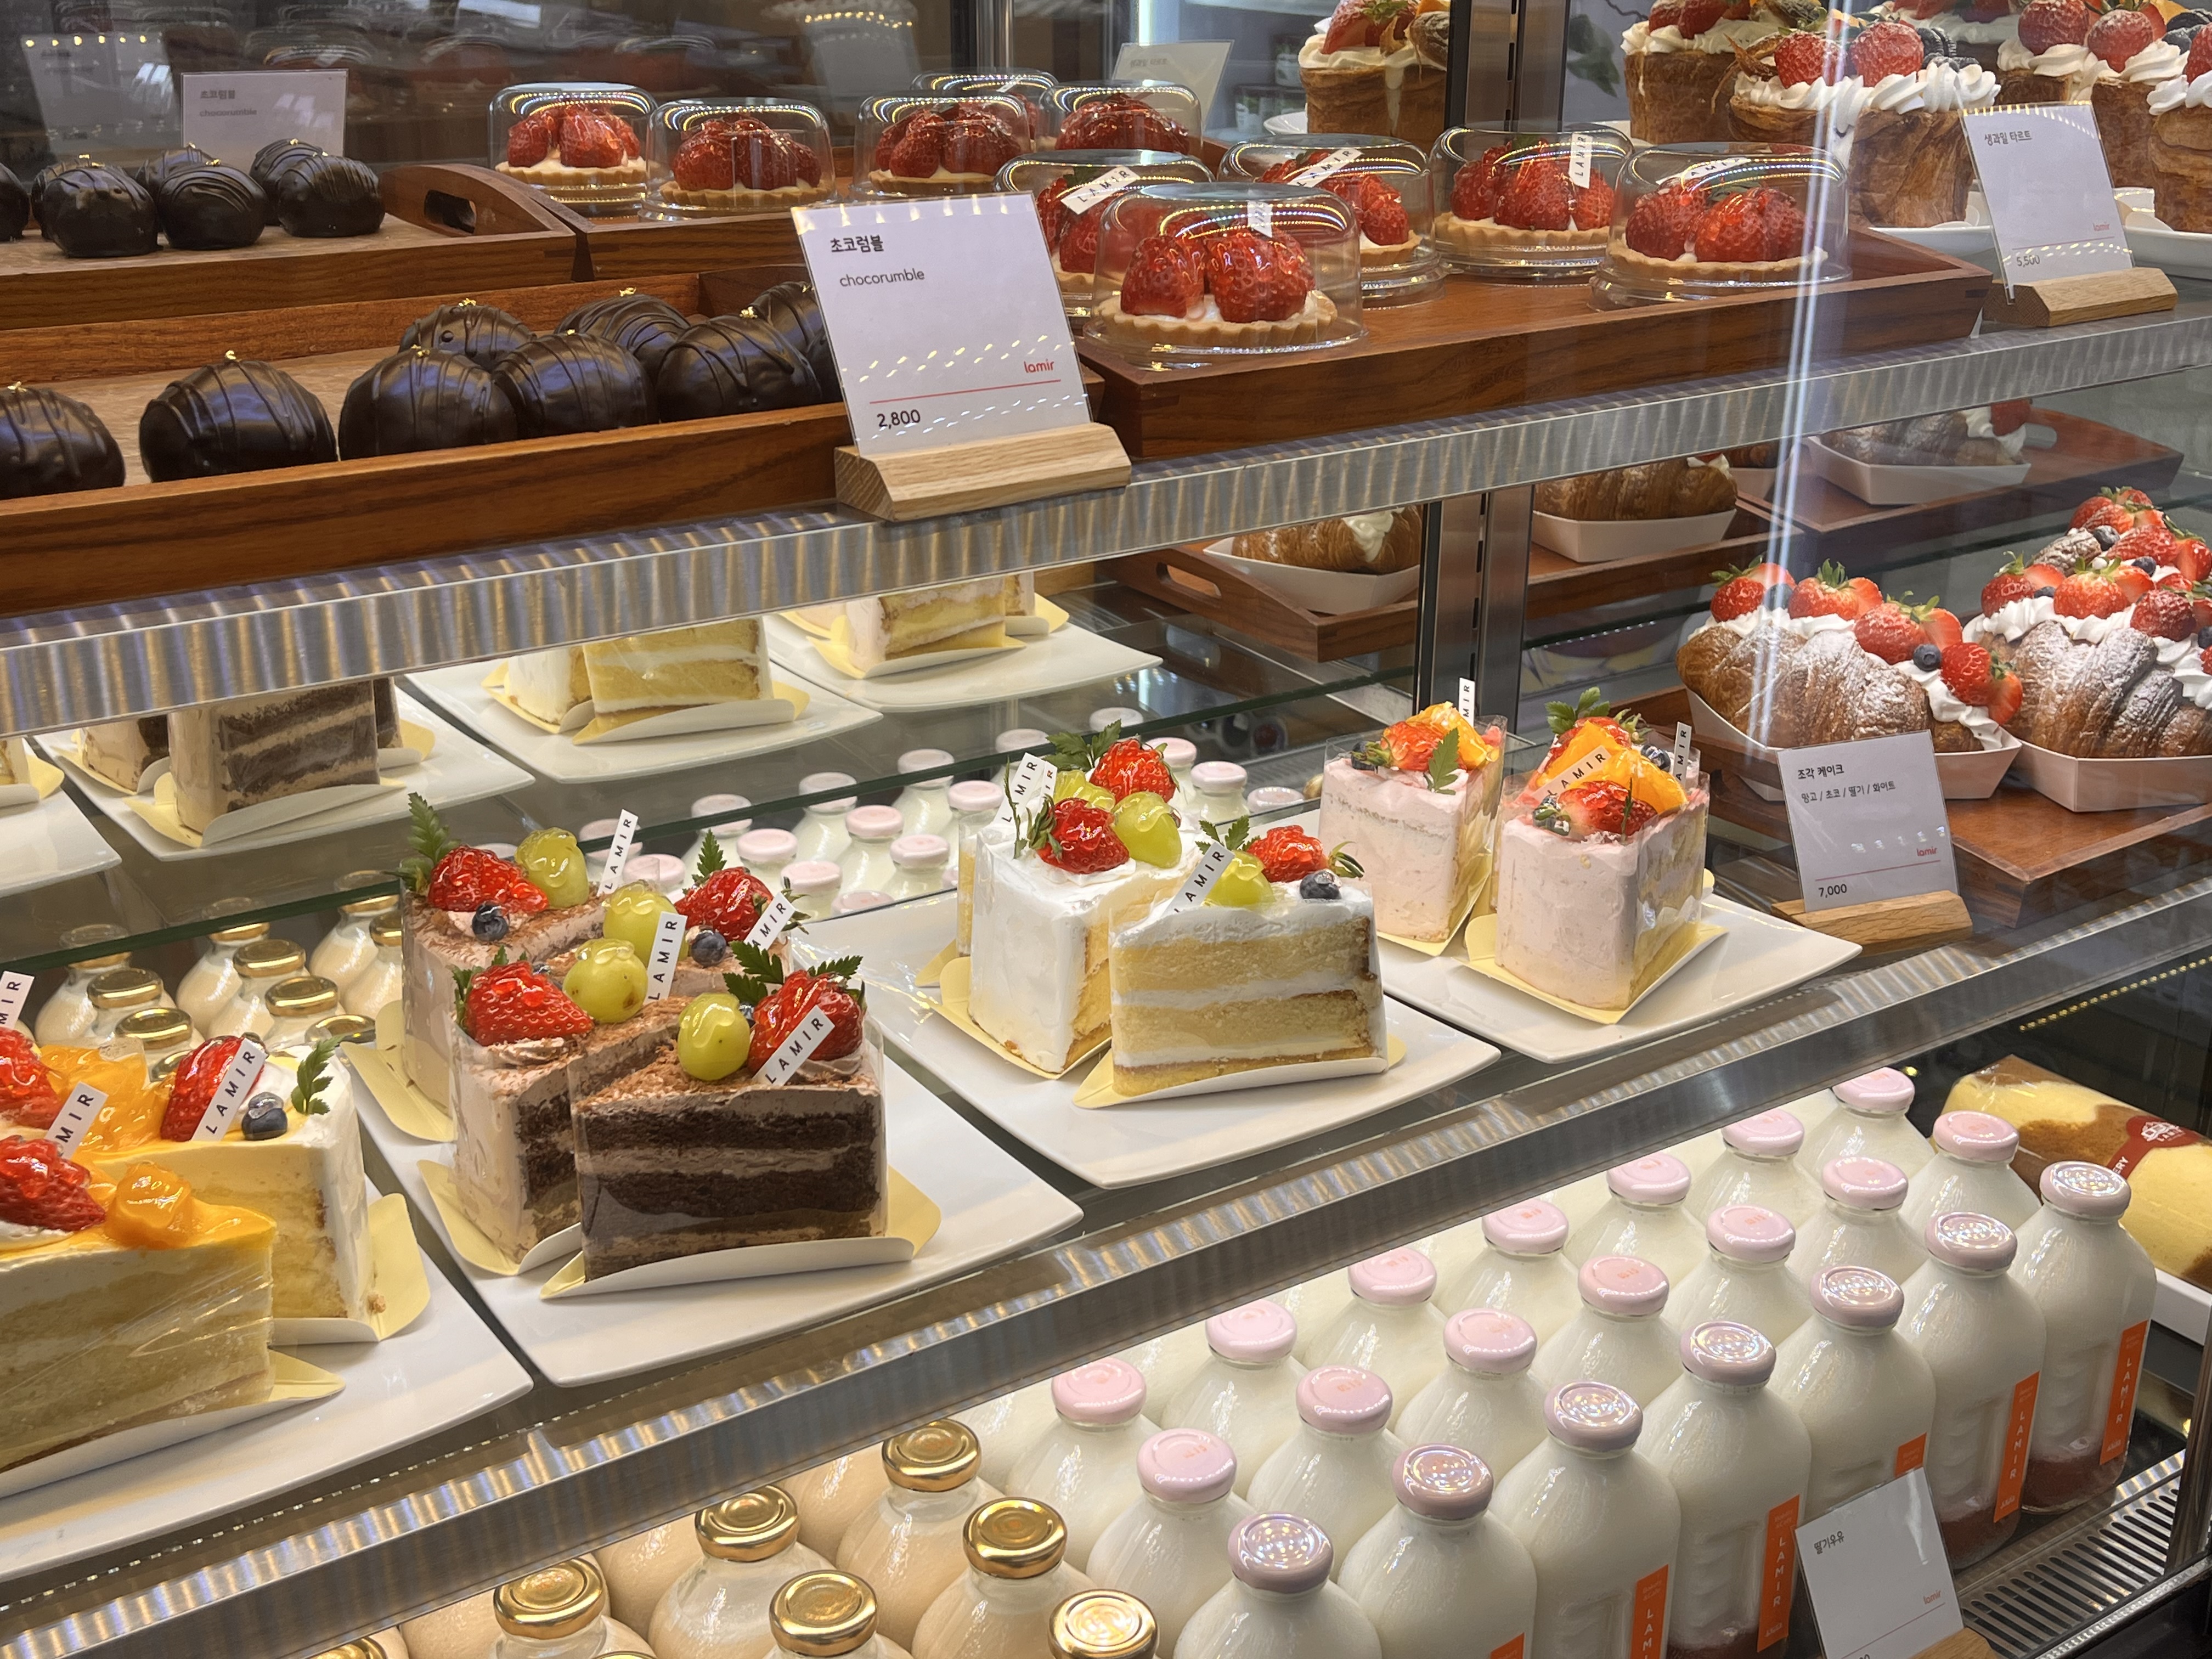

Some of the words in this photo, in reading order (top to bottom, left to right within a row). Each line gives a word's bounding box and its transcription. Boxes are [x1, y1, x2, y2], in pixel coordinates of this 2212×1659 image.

[1984, 132, 2008, 146] 생과일
[2009, 131, 2032, 143] 타르트
[1077, 170, 1130, 203] LAMIR
[2092, 221, 2111, 232] lamir
[830, 234, 884, 253] 초코럼블
[2016, 254, 2040, 268] 5,500
[839, 268, 926, 287] chocorumble
[1024, 358, 1055, 373] lamir
[876, 409, 921, 430] 2,800
[1547, 753, 1606, 796] LAMIR
[1798, 768, 1815, 780] 조각
[1817, 764, 1844, 777] 케이크
[1001, 761, 1037, 822] LMIR
[1801, 792, 1818, 804] 망고
[1826, 788, 1841, 799] 초코
[1848, 785, 1865, 797] 딸기
[605, 819, 631, 890] LAMIR
[1916, 846, 1938, 856] lamir
[1818, 883, 1847, 898] 7,000
[648, 921, 678, 1001] LAMIR
[765, 1017, 823, 1084] LAMIR
[206, 1051, 256, 1135] LAMIR
[2115, 1358, 2132, 1424] LAMIR
[2009, 1410, 2025, 1480] LAMIR
[1814, 1531, 1844, 1555] 딸기우유
[1773, 1537, 1786, 1607] LAMIR
[1923, 1589, 1942, 1605] lamir
